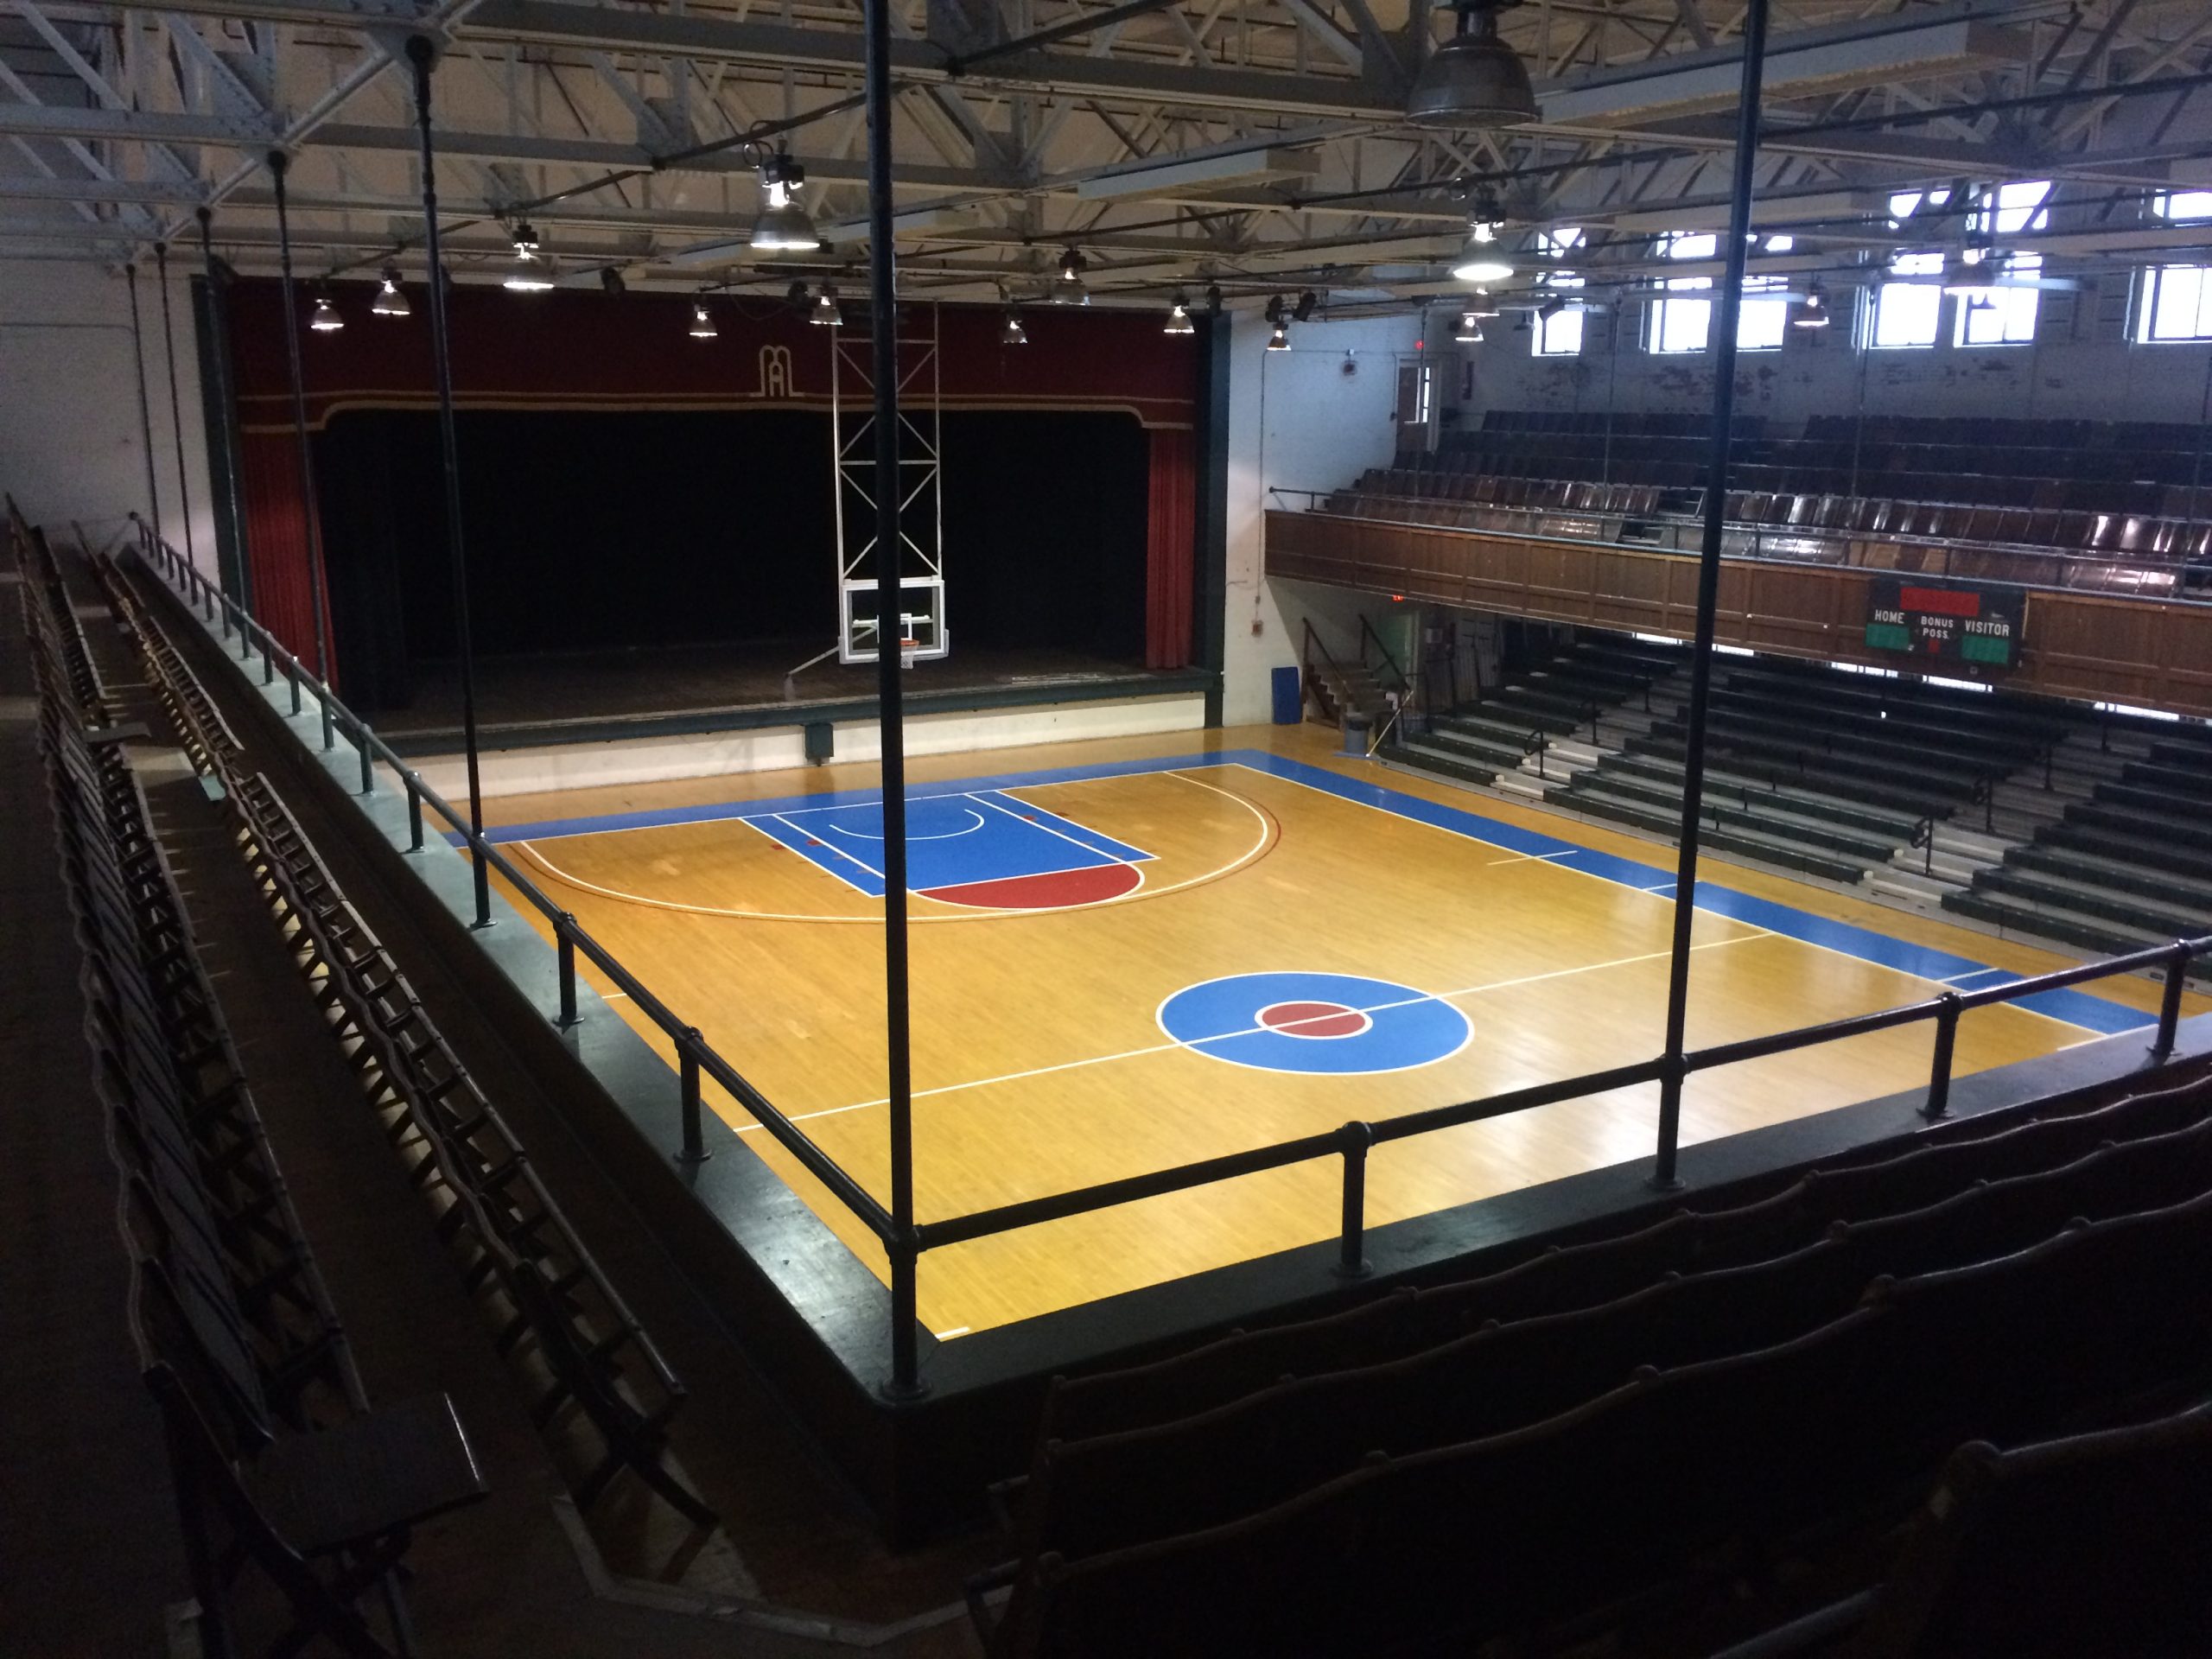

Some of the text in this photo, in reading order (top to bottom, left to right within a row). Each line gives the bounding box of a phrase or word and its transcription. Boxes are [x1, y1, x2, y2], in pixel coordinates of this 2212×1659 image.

[1874, 609, 1905, 624] HOME
[1921, 615, 1954, 628] BONUS
[1965, 620, 2011, 637] VISITOR
